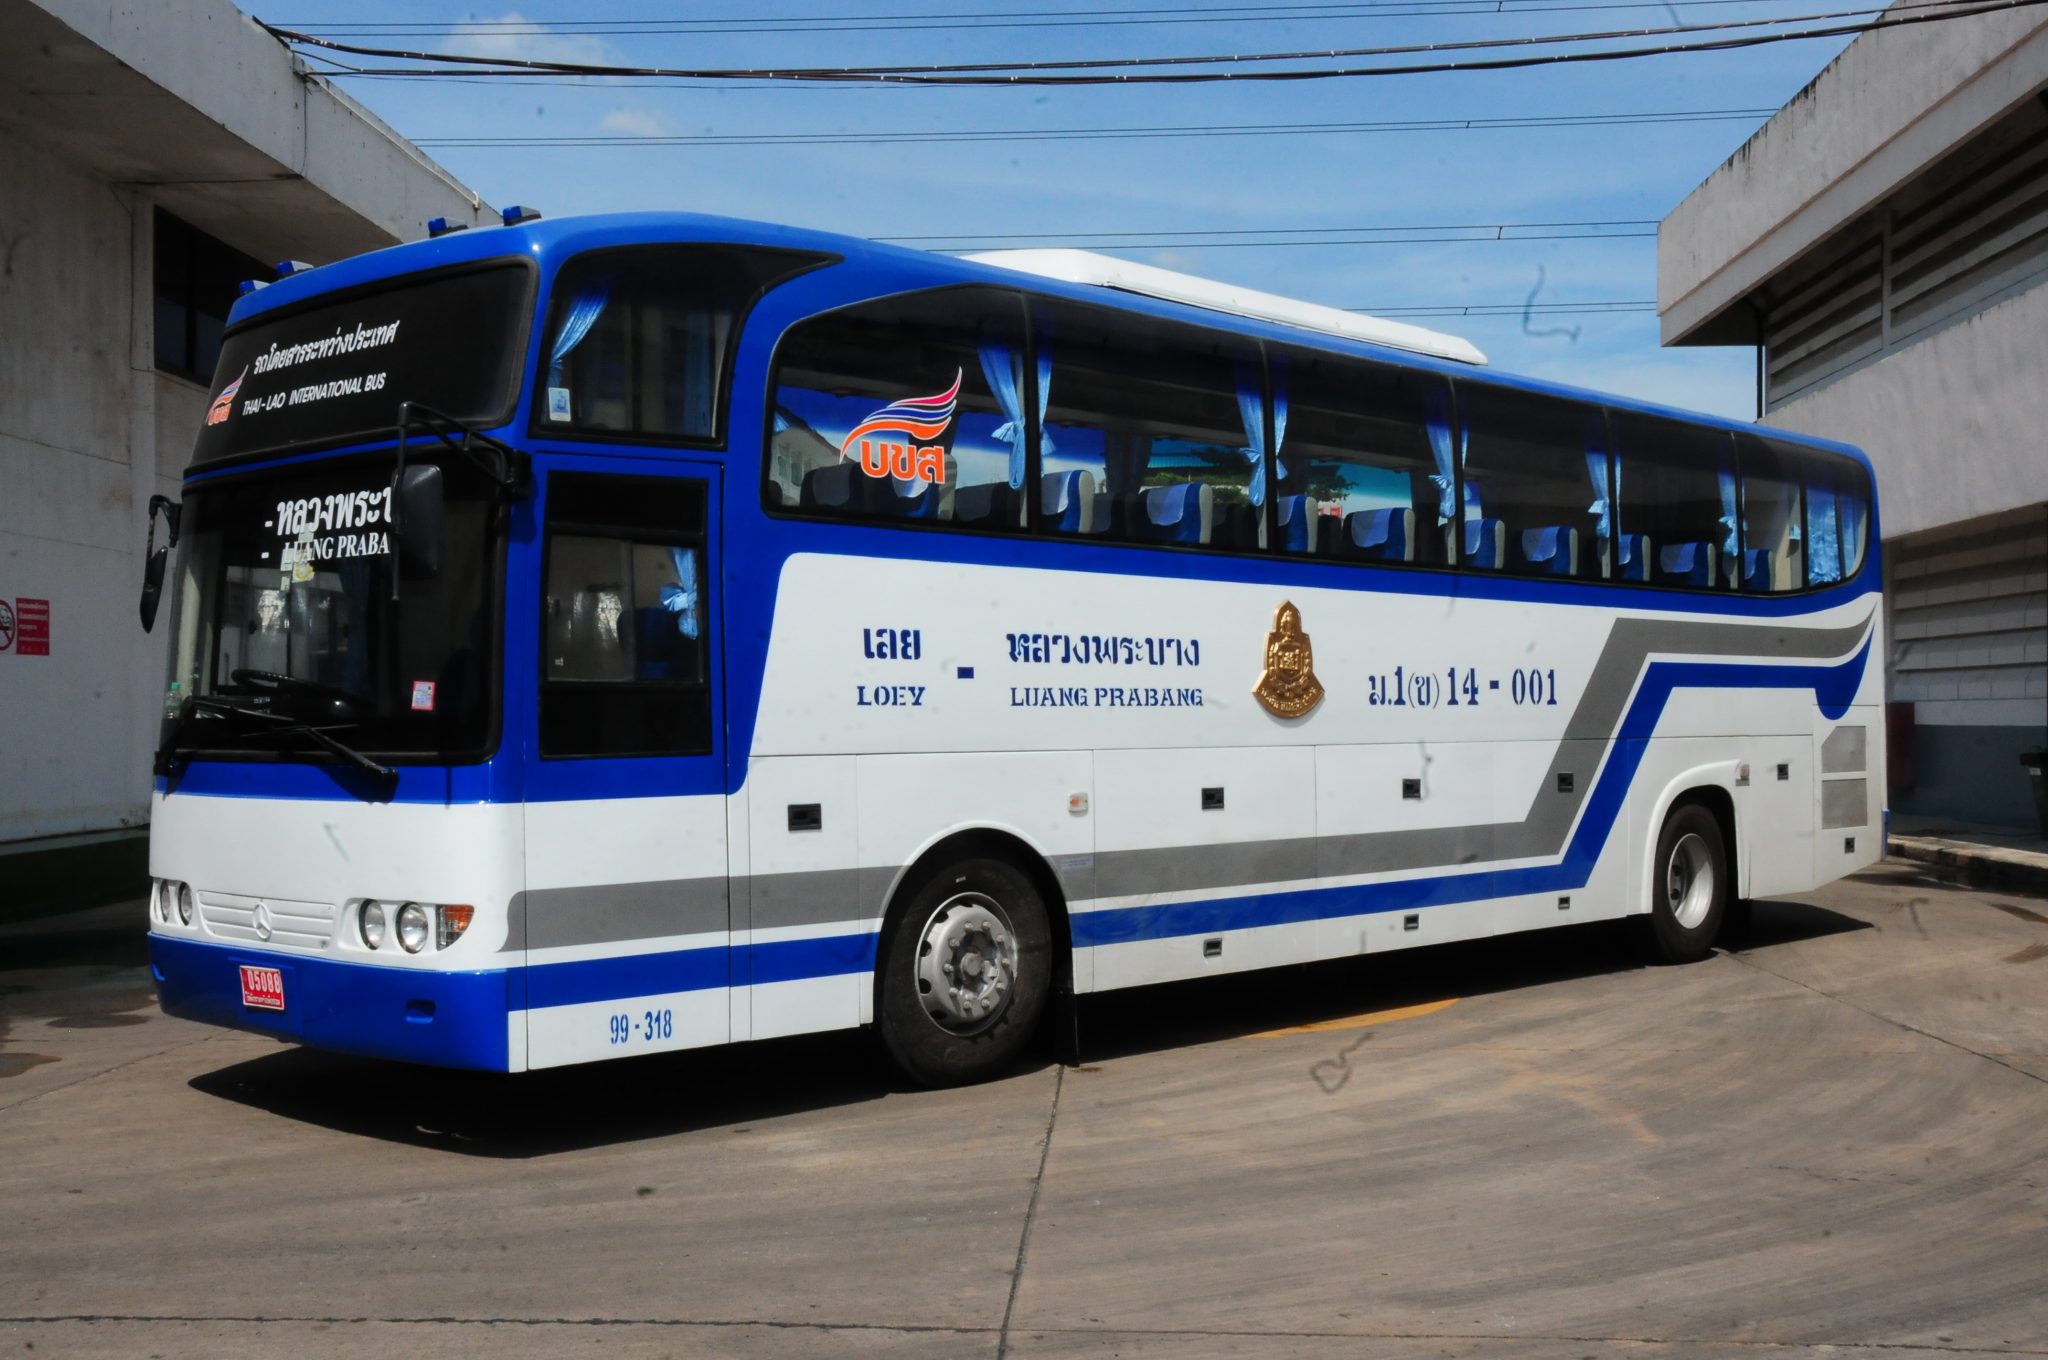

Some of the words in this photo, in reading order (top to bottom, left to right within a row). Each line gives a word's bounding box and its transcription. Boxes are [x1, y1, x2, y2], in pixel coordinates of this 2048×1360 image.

[242, 392, 286, 415] THAI-LAO
[288, 378, 362, 406] INTERNATIONAL
[364, 371, 387, 392] BUS
[860, 440, 945, 483] บขส
[863, 628, 921, 660] เลย
[1006, 633, 1200, 667] หลวงพระบาง
[856, 685, 926, 706] LOEY
[1010, 687, 1089, 707] LUANG
[1094, 687, 1204, 707] PRABANG
